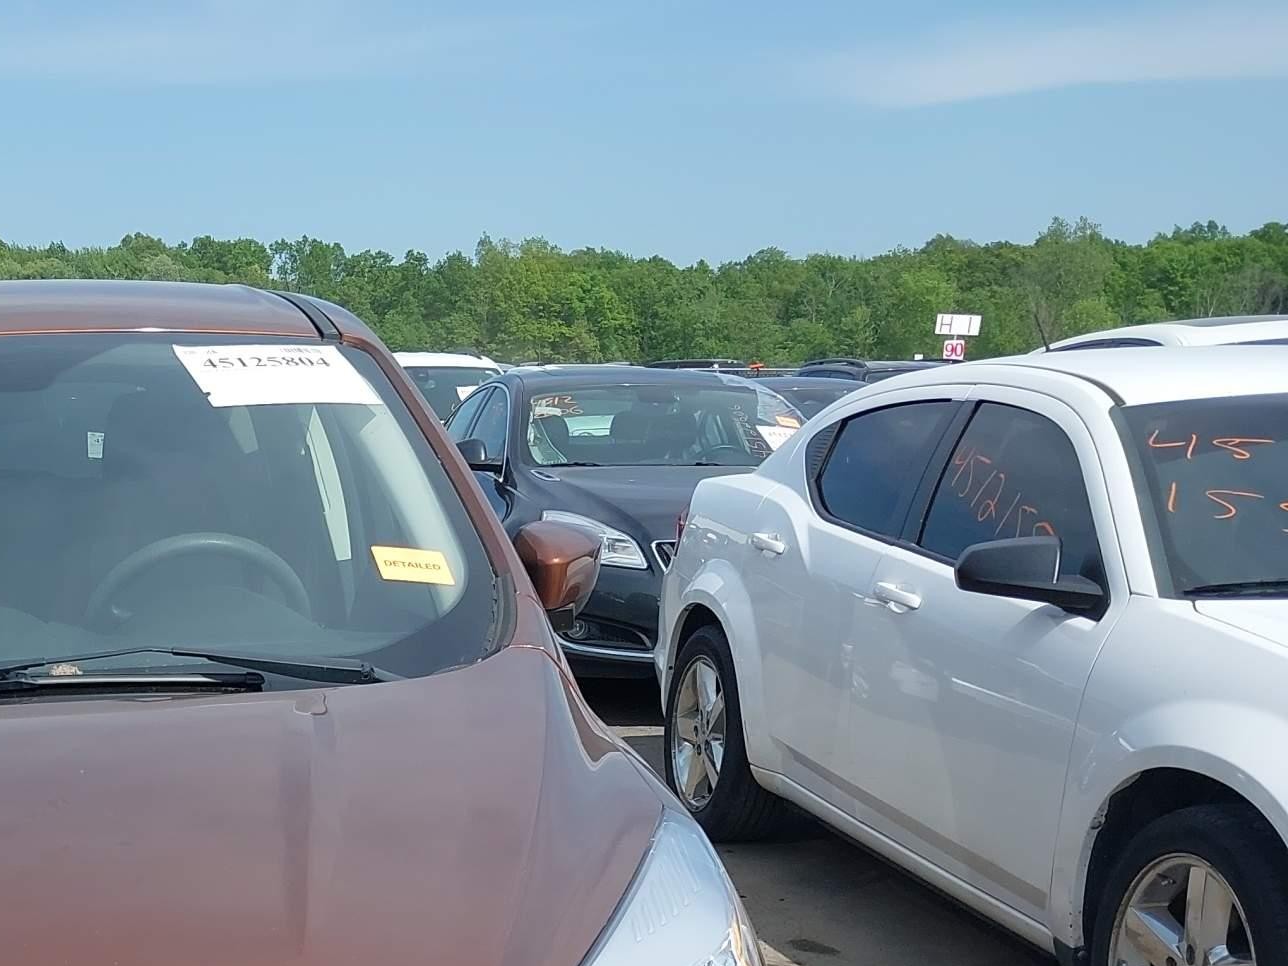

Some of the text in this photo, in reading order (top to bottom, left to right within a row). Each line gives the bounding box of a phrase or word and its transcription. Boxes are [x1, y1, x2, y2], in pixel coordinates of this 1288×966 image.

[944, 343, 964, 357] 90
[203, 356, 330, 369] 45125804
[384, 560, 441, 570] DETAILED
